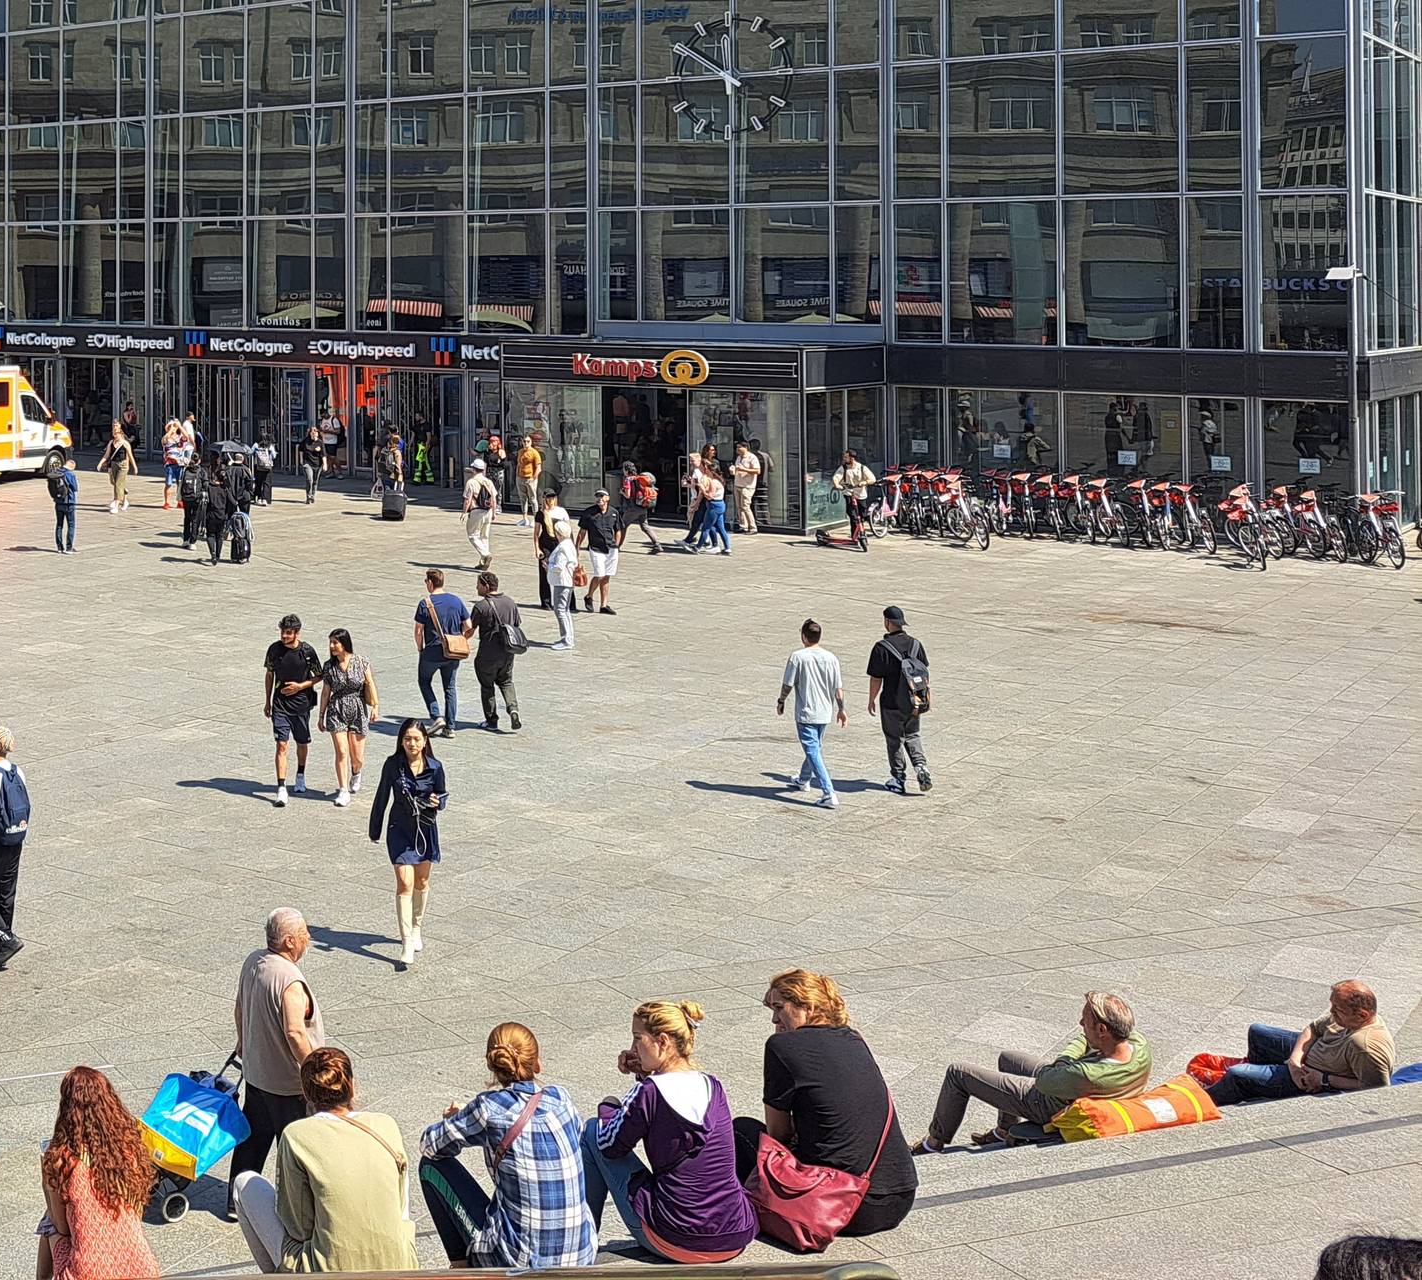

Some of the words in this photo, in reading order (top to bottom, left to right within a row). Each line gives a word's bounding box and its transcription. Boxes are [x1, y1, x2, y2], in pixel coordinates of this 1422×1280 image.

[256, 315, 301, 327] Leonidas
[6, 331, 77, 349] NetCologne
[106, 333, 175, 352] Highspeed
[209, 337, 293, 356] NetCologne
[333, 339, 416, 360] Highspeed
[572, 352, 659, 383] Kamps
